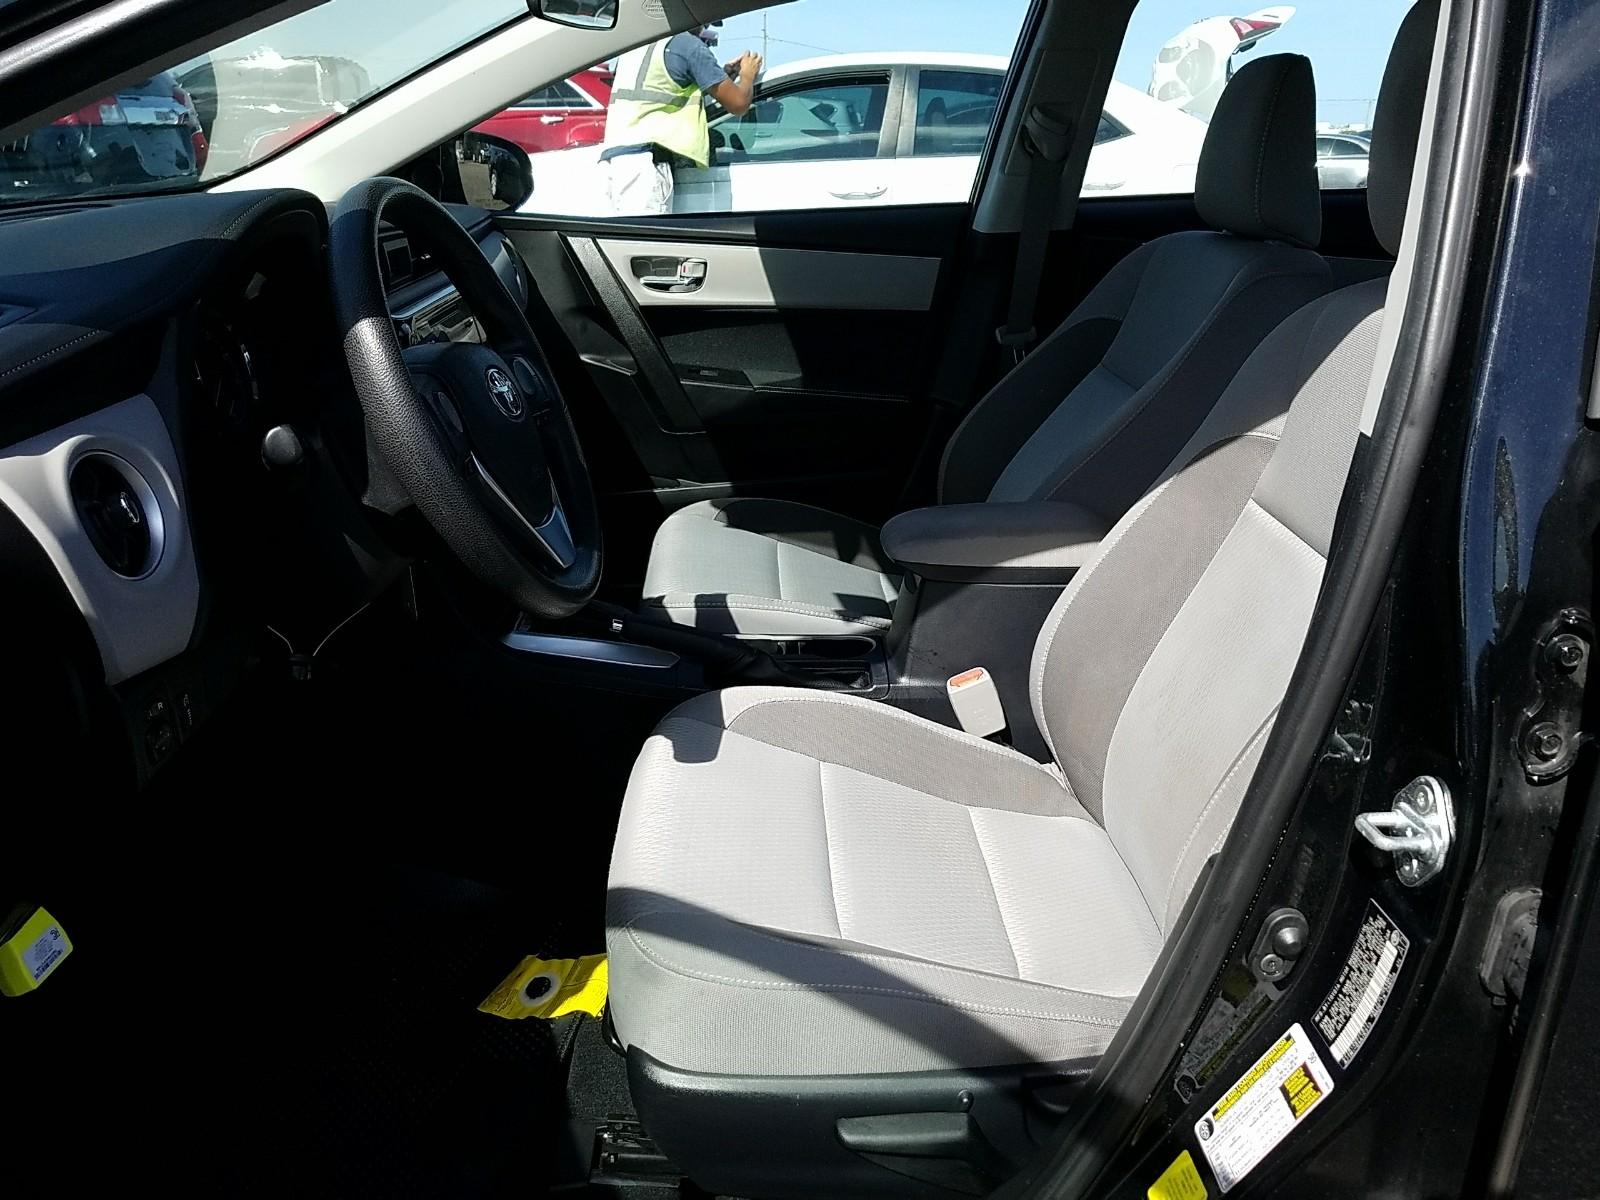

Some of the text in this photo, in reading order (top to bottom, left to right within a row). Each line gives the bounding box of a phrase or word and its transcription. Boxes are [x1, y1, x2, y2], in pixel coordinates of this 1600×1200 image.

[157, 701, 164, 710] R
[1217, 1097, 1228, 1111] TIRE
[1226, 1087, 1239, 1101] AND
[1236, 1068, 1257, 1091] LOADING
